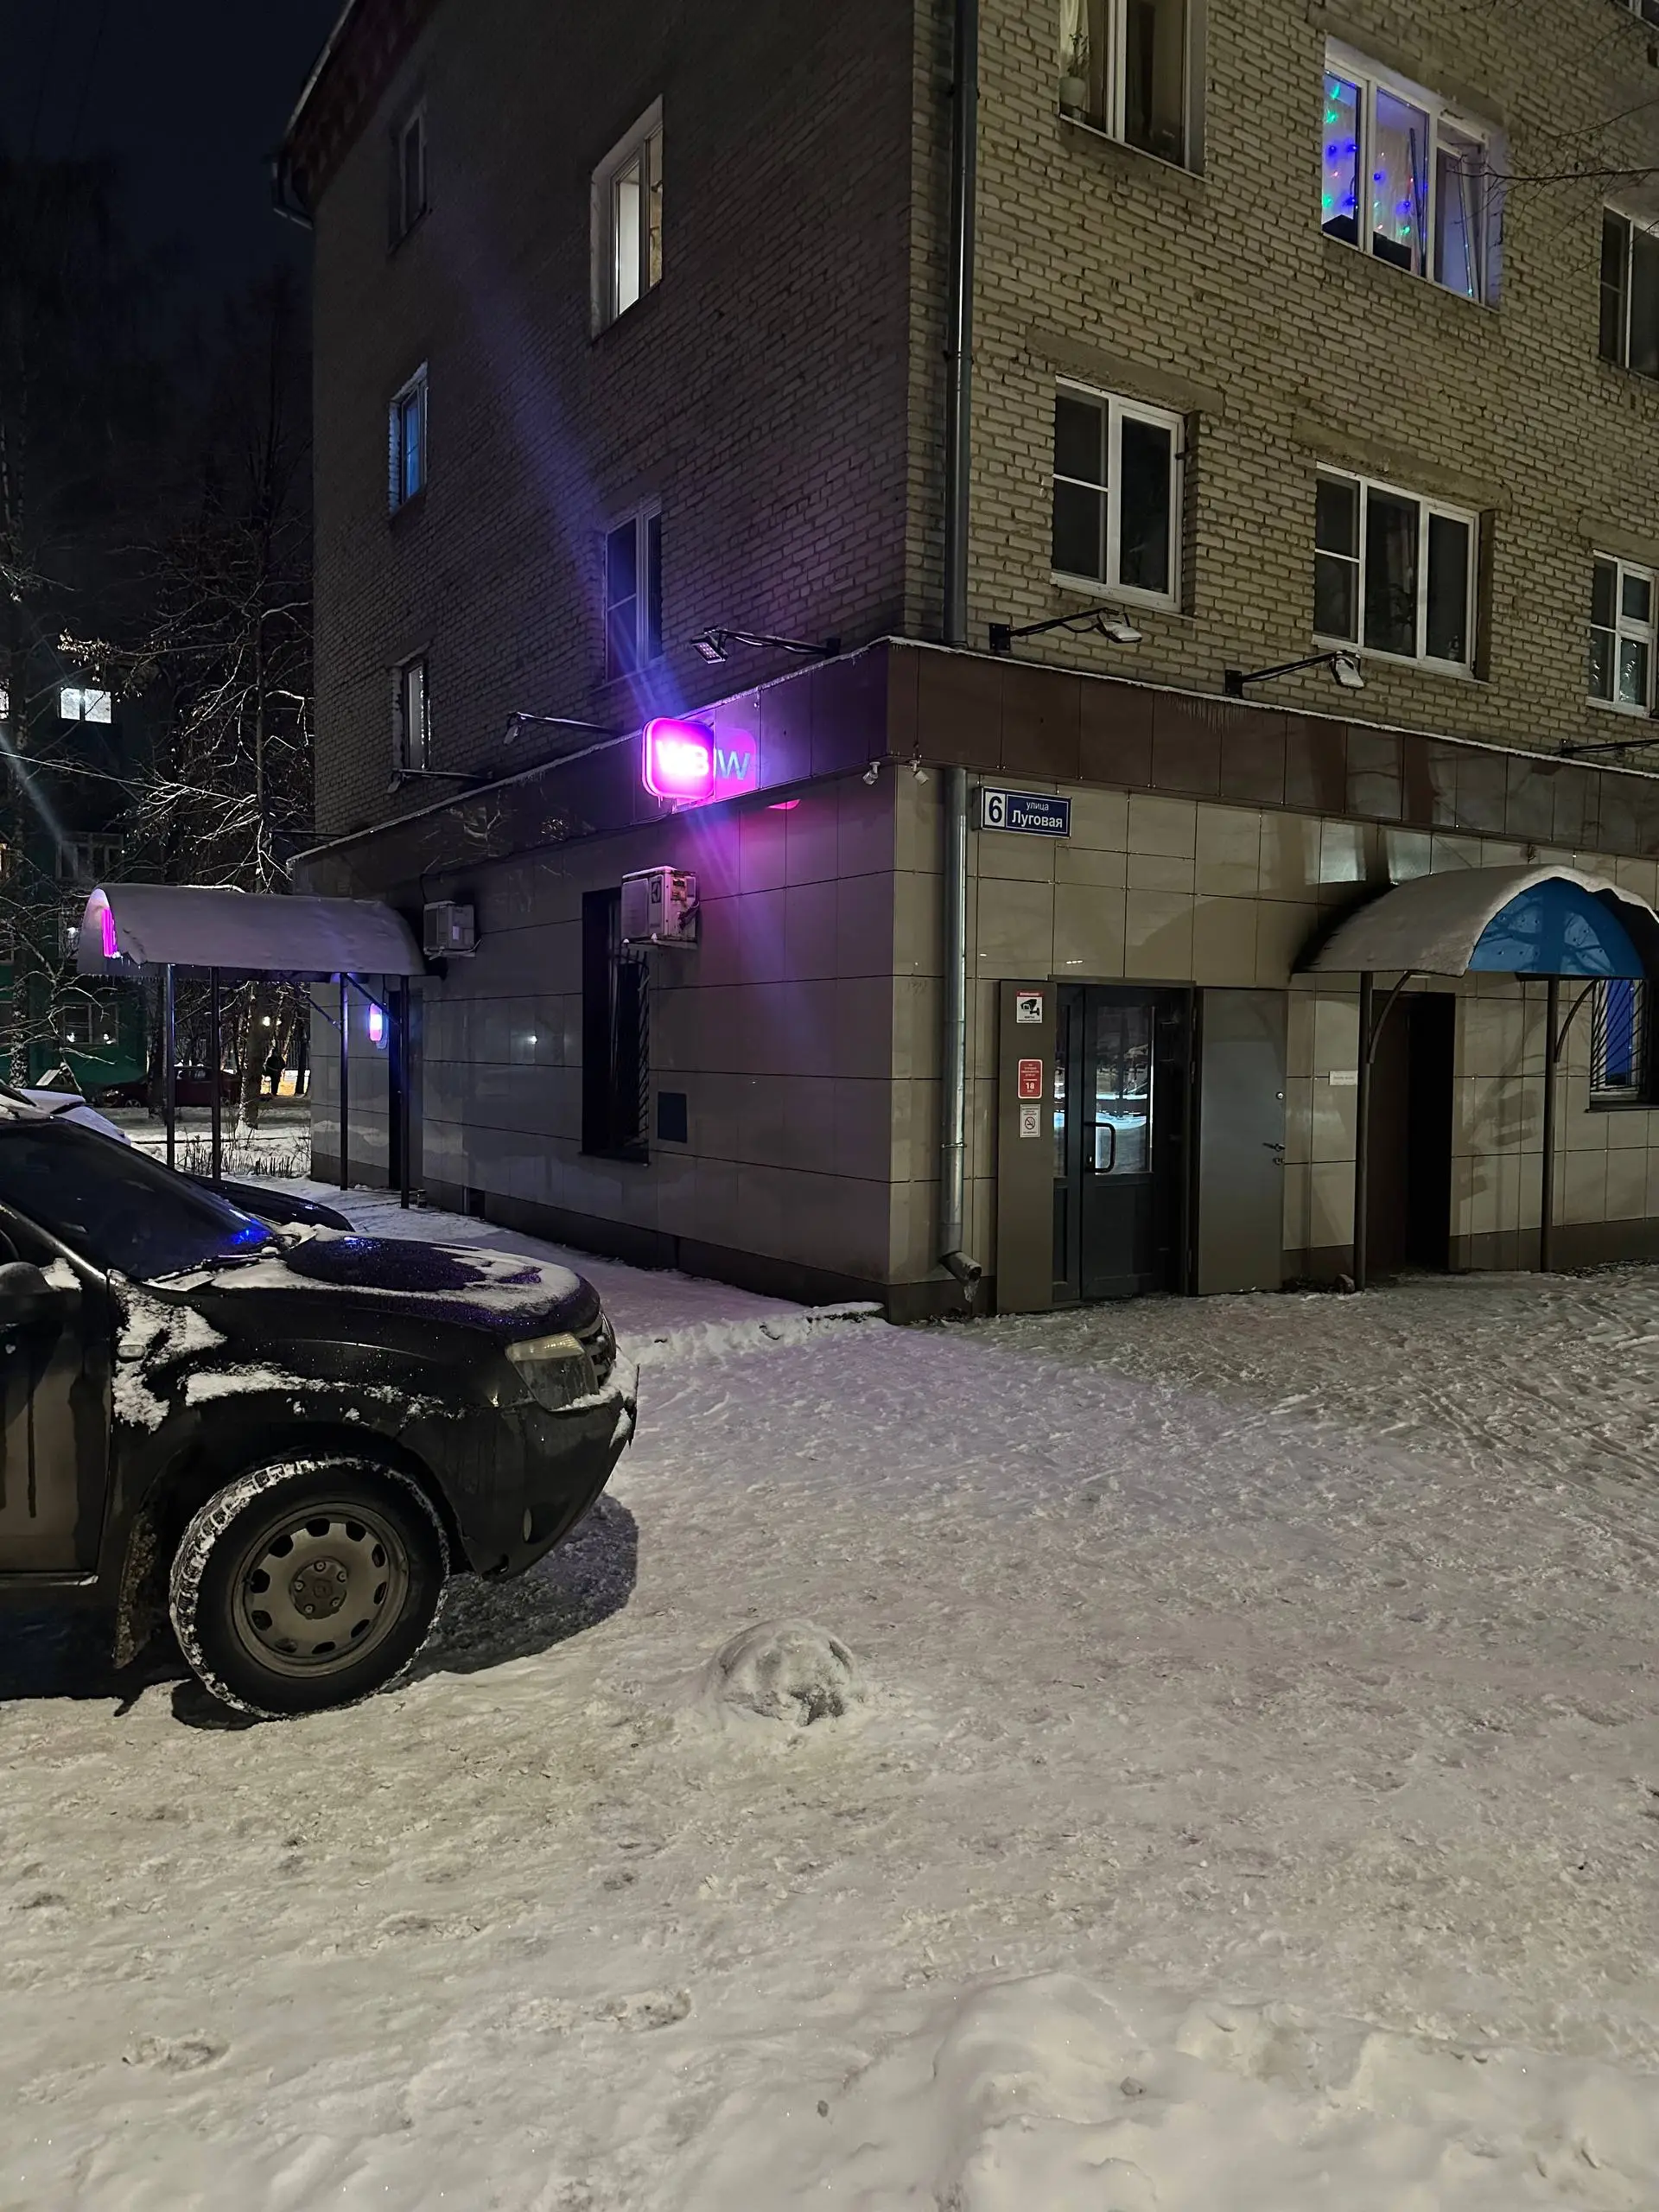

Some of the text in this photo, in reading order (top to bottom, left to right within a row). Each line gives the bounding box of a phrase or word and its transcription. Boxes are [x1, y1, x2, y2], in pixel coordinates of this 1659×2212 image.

[989, 796, 1002, 823] 6
[1026, 802, 1049, 810] улица
[1012, 810, 1063, 828] Луговая
